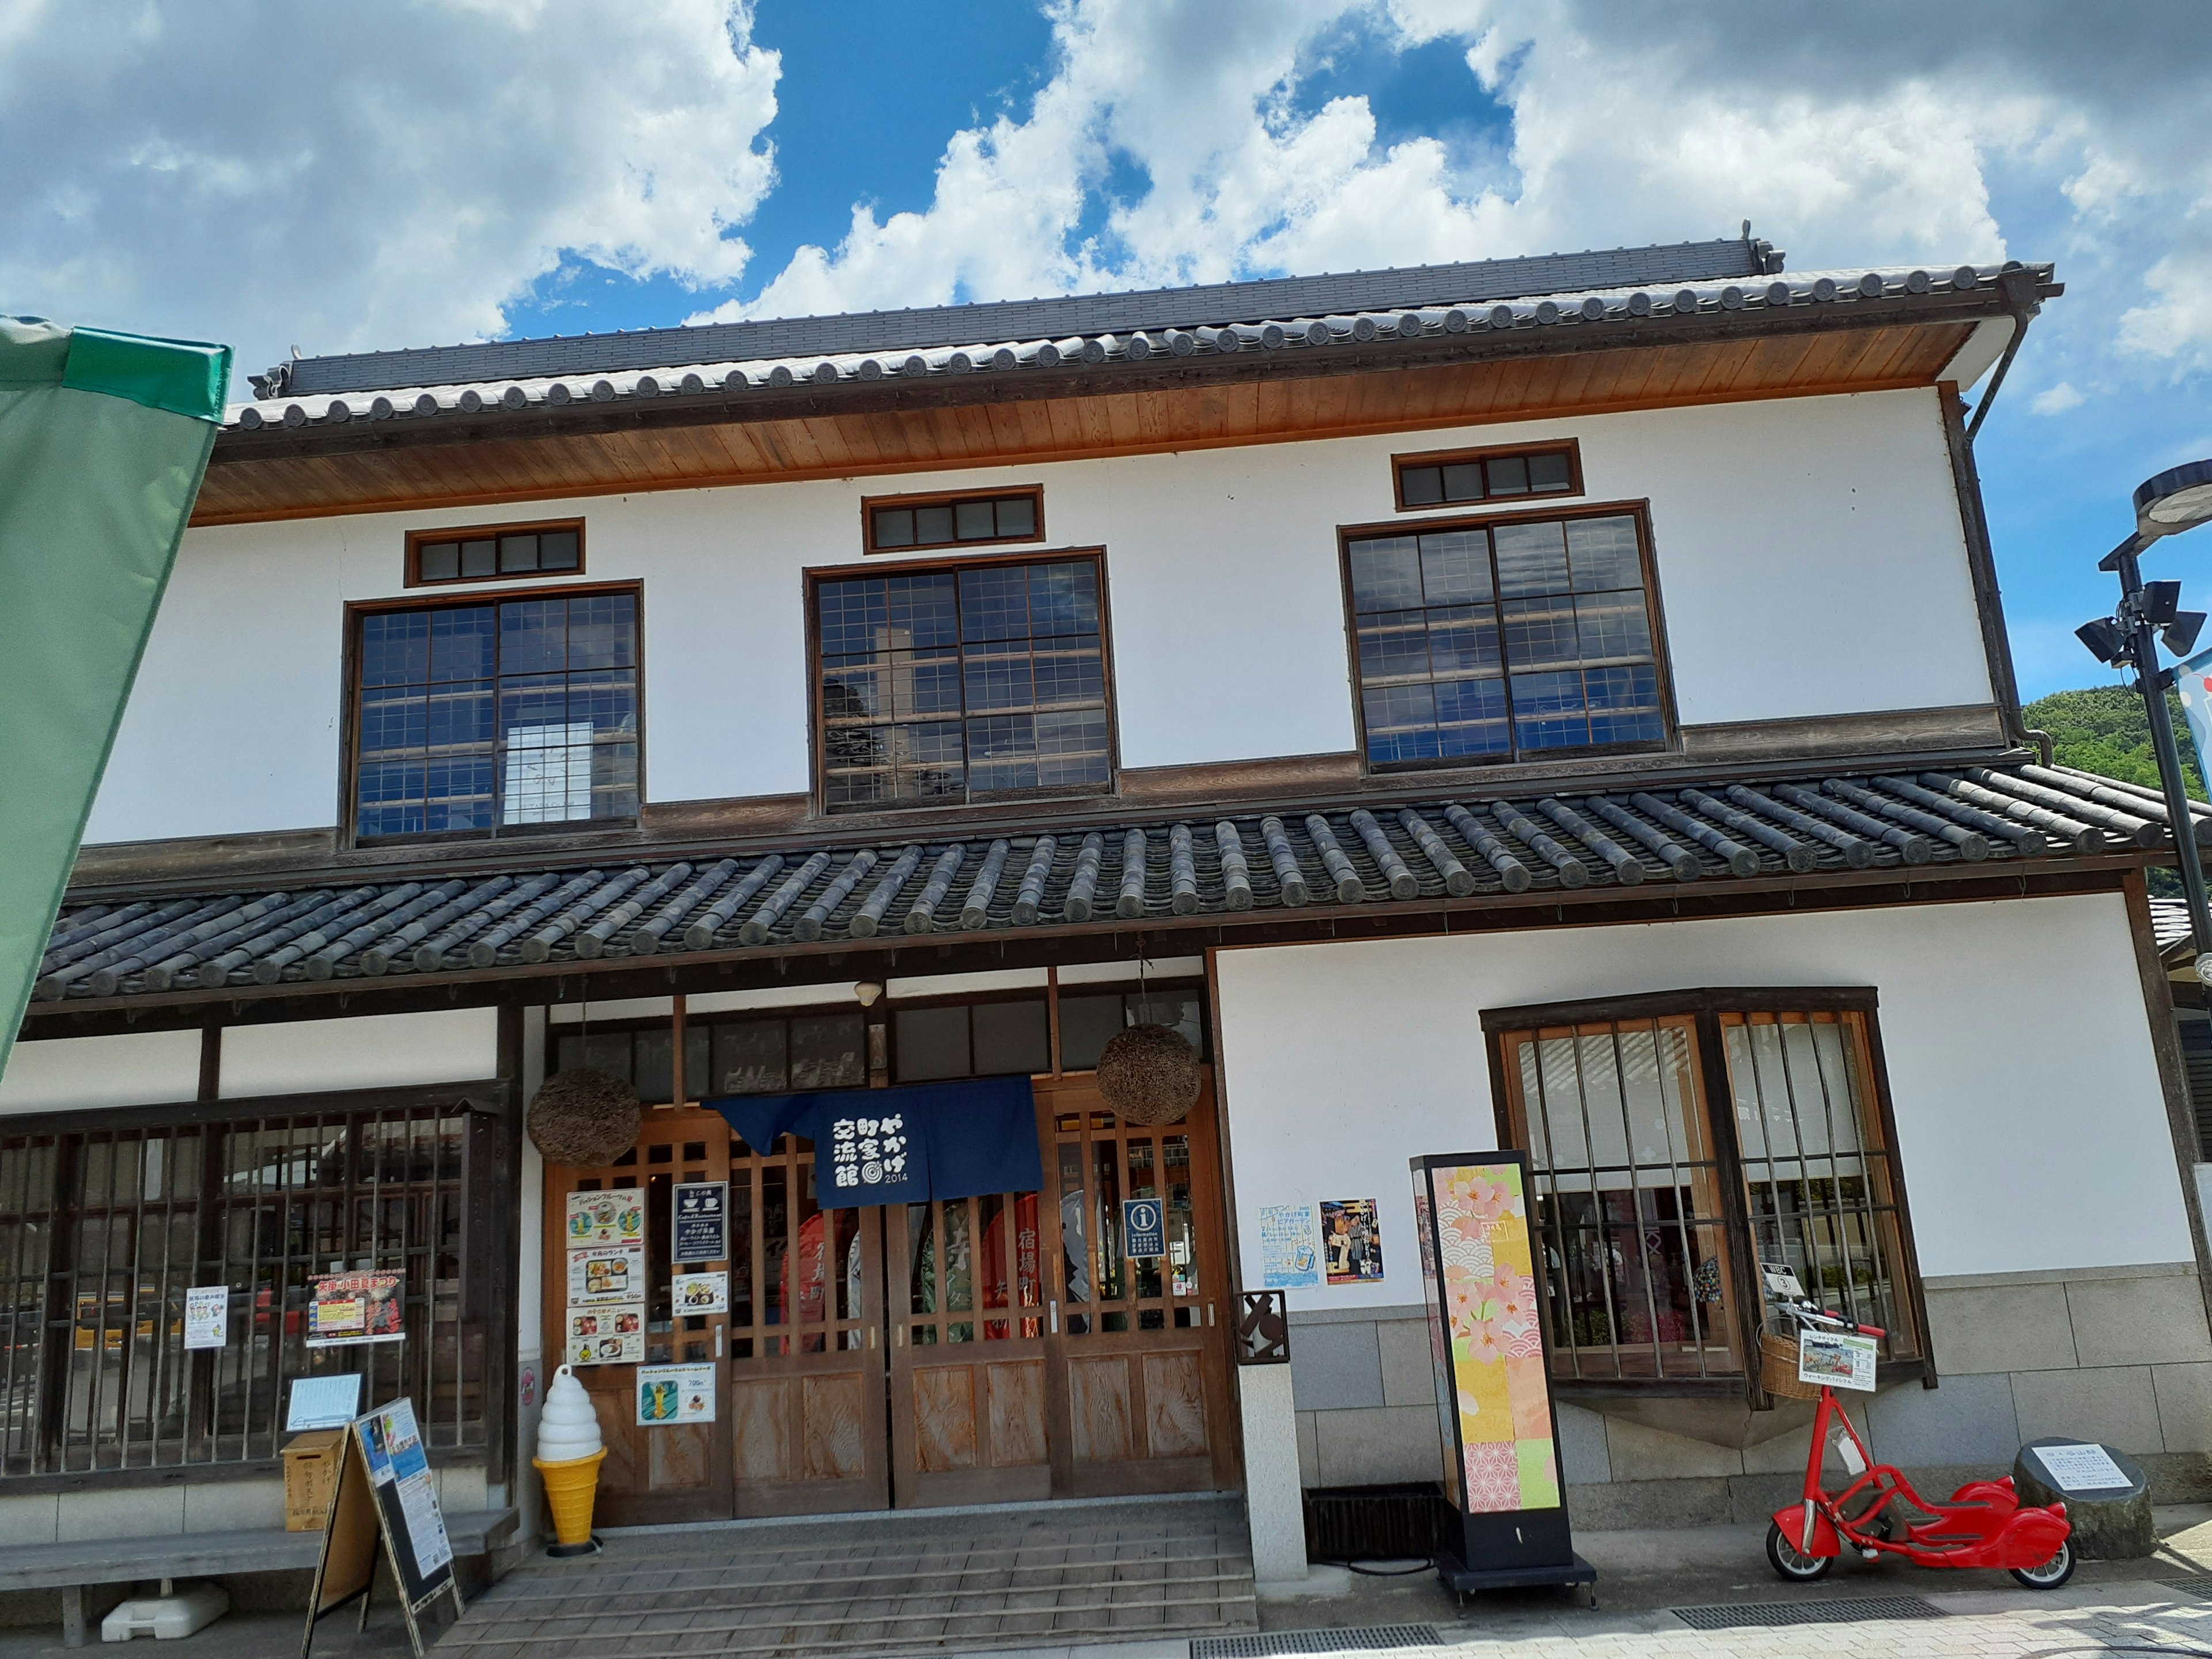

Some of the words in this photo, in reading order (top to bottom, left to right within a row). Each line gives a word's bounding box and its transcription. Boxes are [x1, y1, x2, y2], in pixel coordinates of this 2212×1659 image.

[857, 1118, 881, 1160] 町家
[880, 1113, 907, 1173] やかげ
[832, 1118, 859, 1187] 交流館
[884, 1173, 908, 1184] 2014
[1768, 1265, 1787, 1275] WBC
[1809, 1334, 1839, 1342] レンタサイクル
[1803, 1373, 1852, 1384] ウォーキングバイシクル
